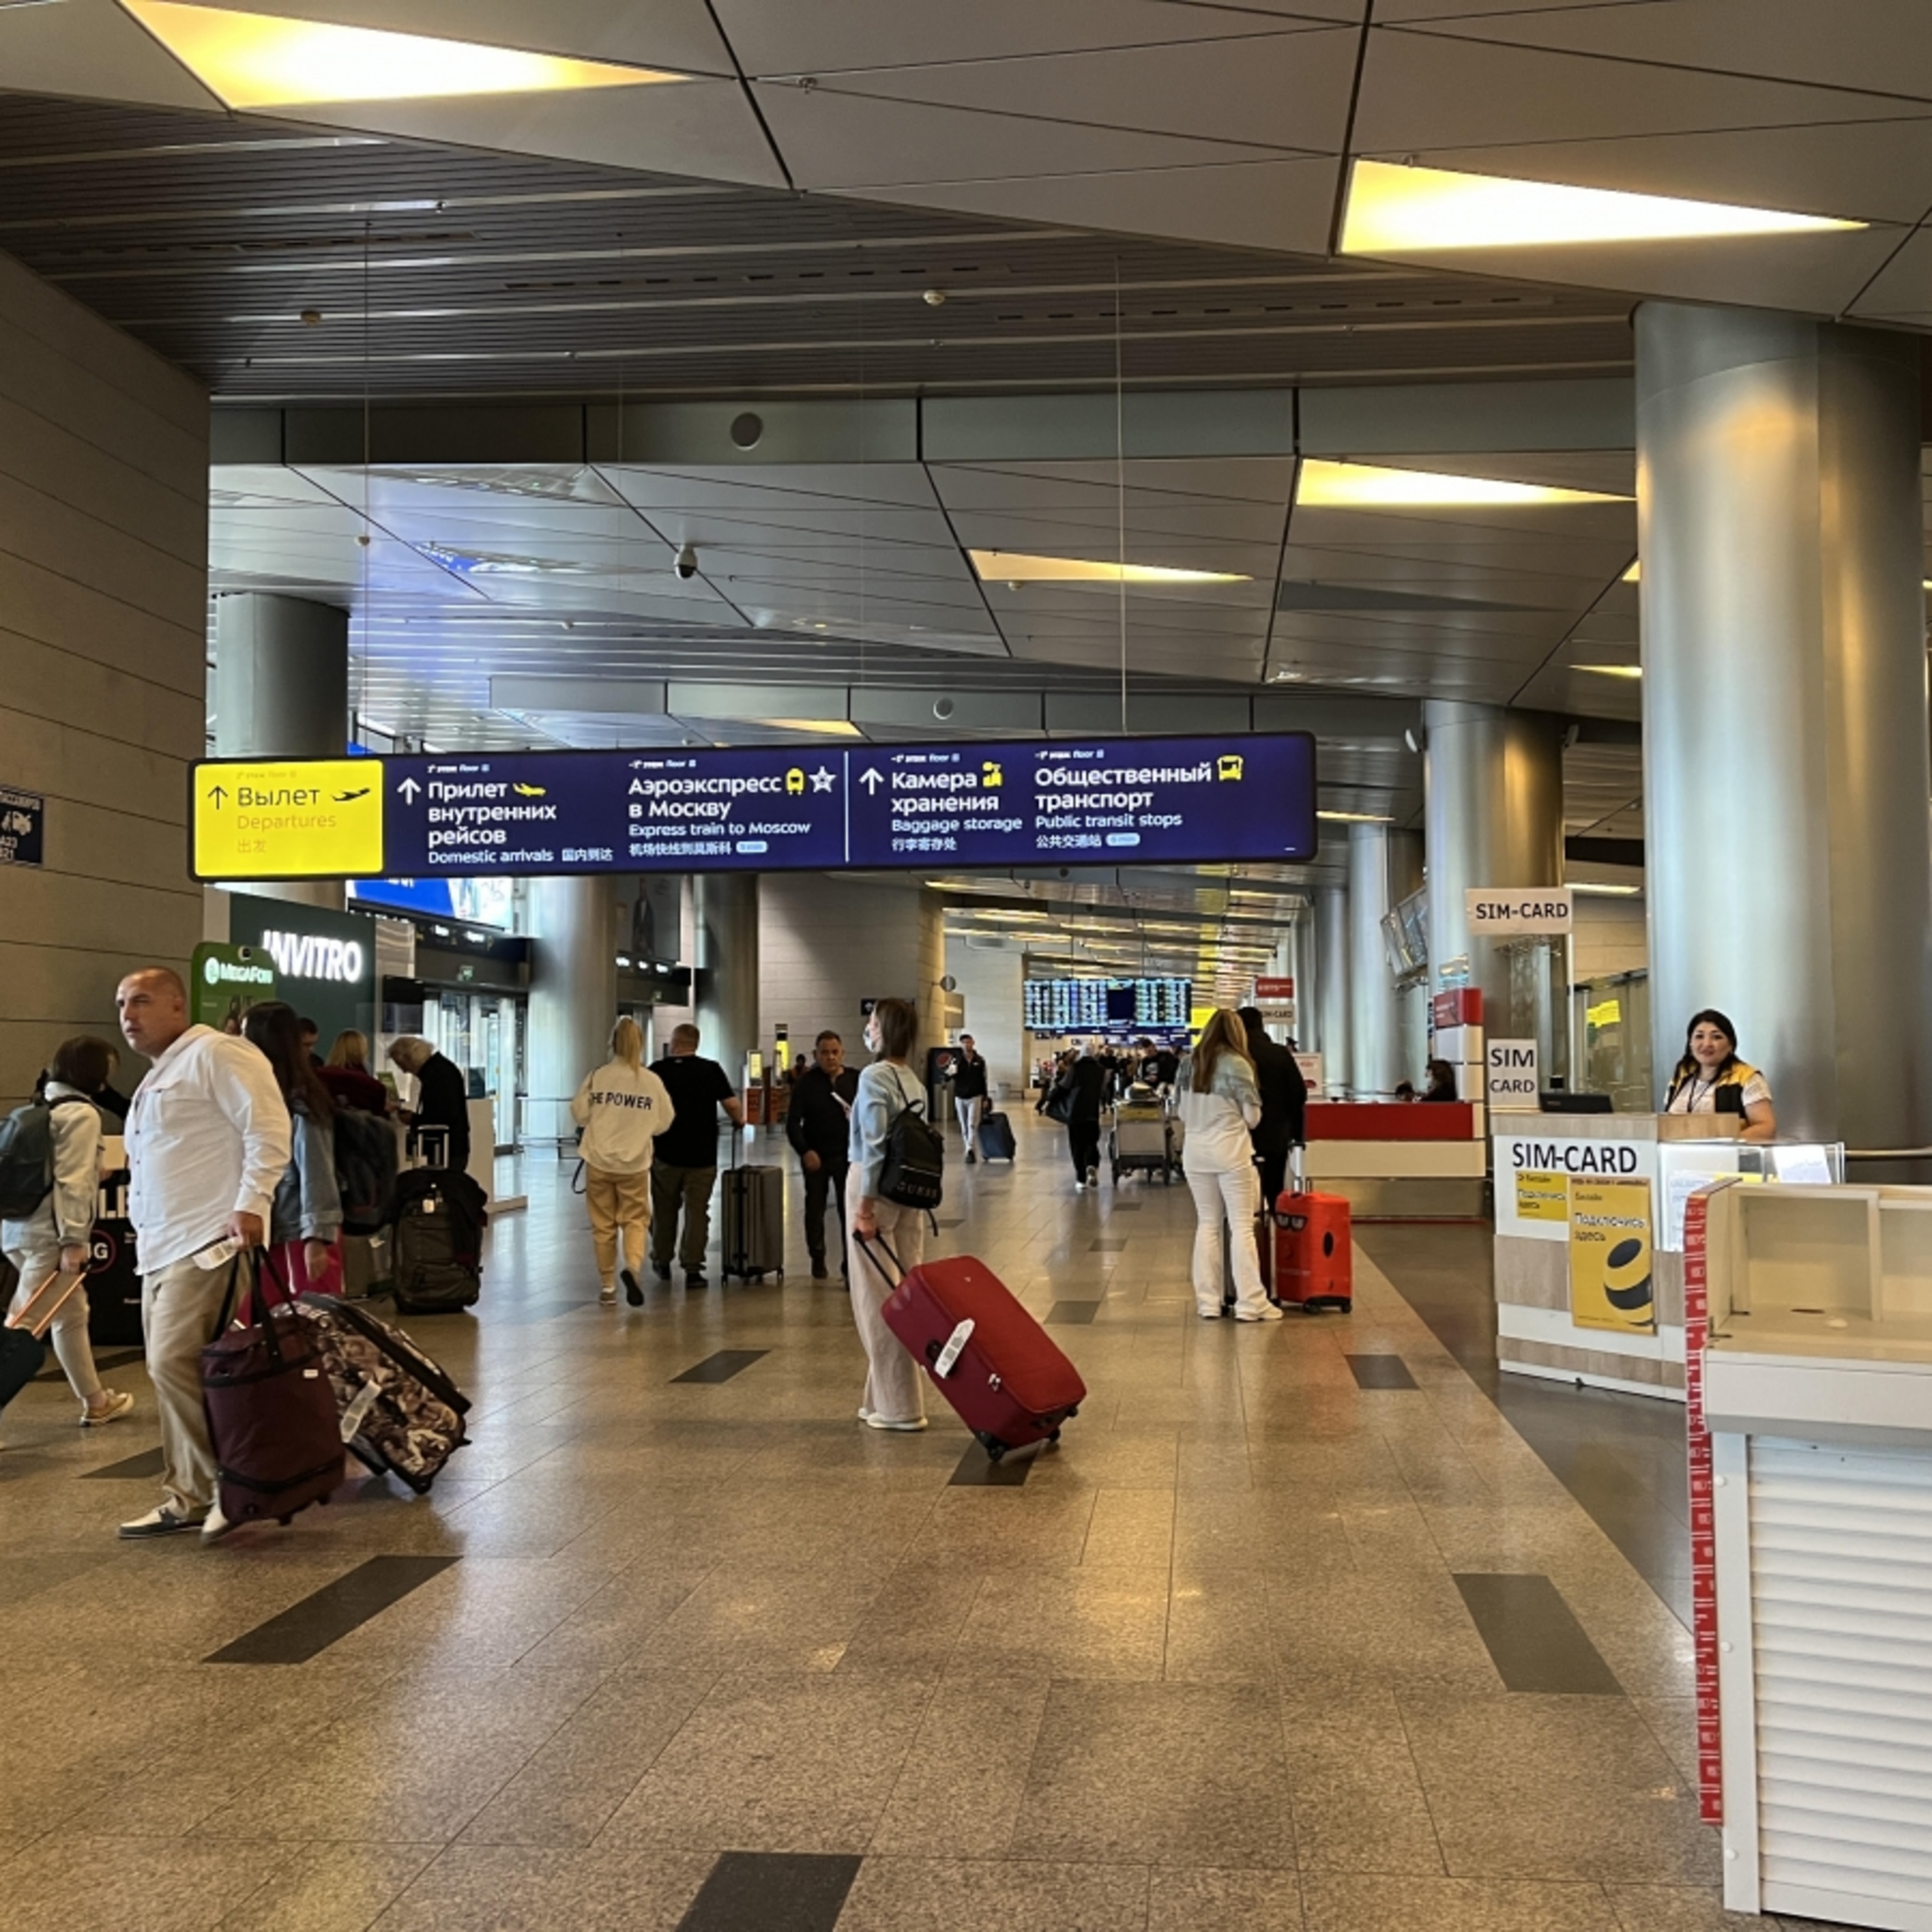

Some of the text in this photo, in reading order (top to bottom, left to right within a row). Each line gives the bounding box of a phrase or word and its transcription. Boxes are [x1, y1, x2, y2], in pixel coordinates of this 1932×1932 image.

[891, 772, 978, 792] Камера
[1035, 762, 1212, 787] Общественный
[237, 786, 320, 807] Вылет
[428, 781, 507, 803] Прилет
[628, 777, 782, 798] Аэроэкспресс
[629, 801, 732, 820] в Москву
[891, 795, 999, 817] хранения
[1035, 791, 1153, 813] транспорт
[238, 813, 337, 832] Departures
[428, 805, 557, 825] внутренних
[1036, 813, 1183, 829] Public transit stops
[629, 822, 811, 839] Express train to Moscow
[891, 817, 1023, 834] Baggage storage
[428, 826, 507, 849] рейсов
[428, 847, 554, 864] Domestic arrivals
[1476, 902, 1569, 920] SIM-CARD
[1490, 1047, 1534, 1068] SIM
[1490, 1079, 1535, 1094] CARD
[605, 1092, 653, 1110] POWER
[1512, 1142, 1637, 1173] SIM-CARD
